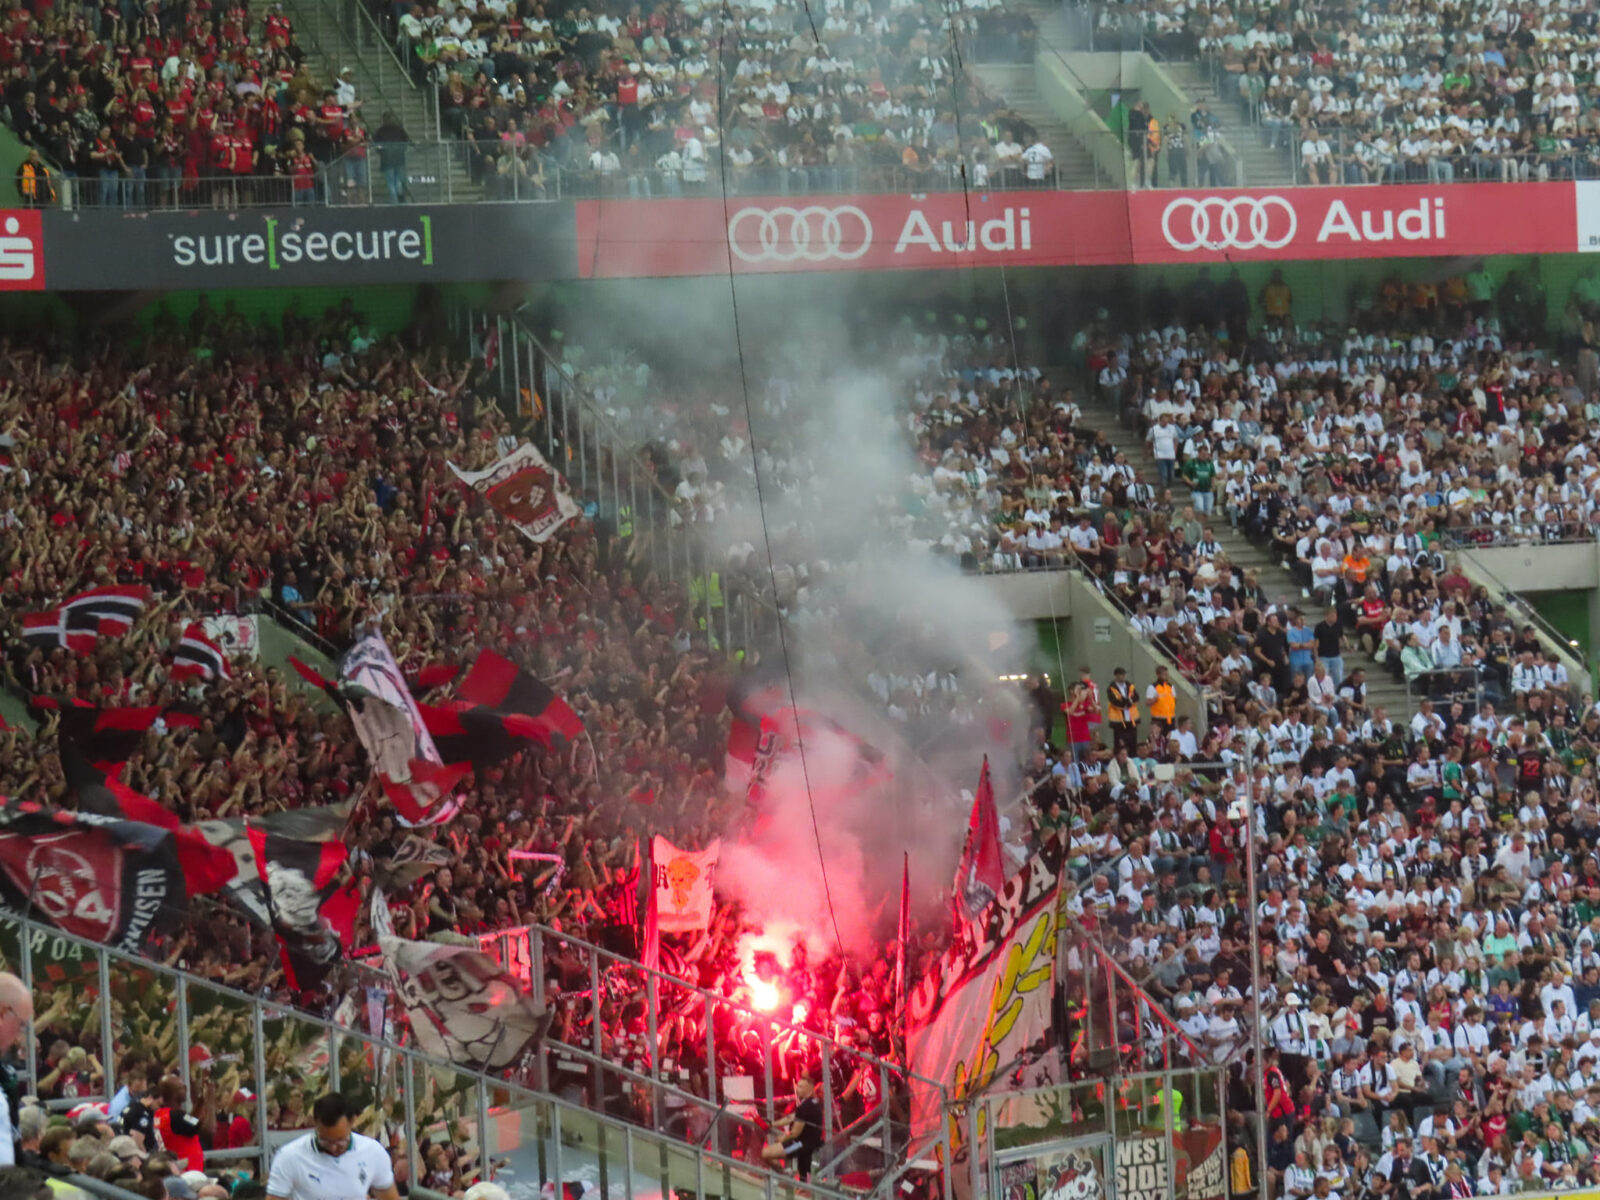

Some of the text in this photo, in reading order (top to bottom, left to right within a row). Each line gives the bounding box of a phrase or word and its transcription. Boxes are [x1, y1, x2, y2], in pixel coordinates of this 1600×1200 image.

[894, 207, 1031, 254] Audi
[1316, 198, 1446, 243] Audi
[1114, 1162, 1168, 1192] SIDE
